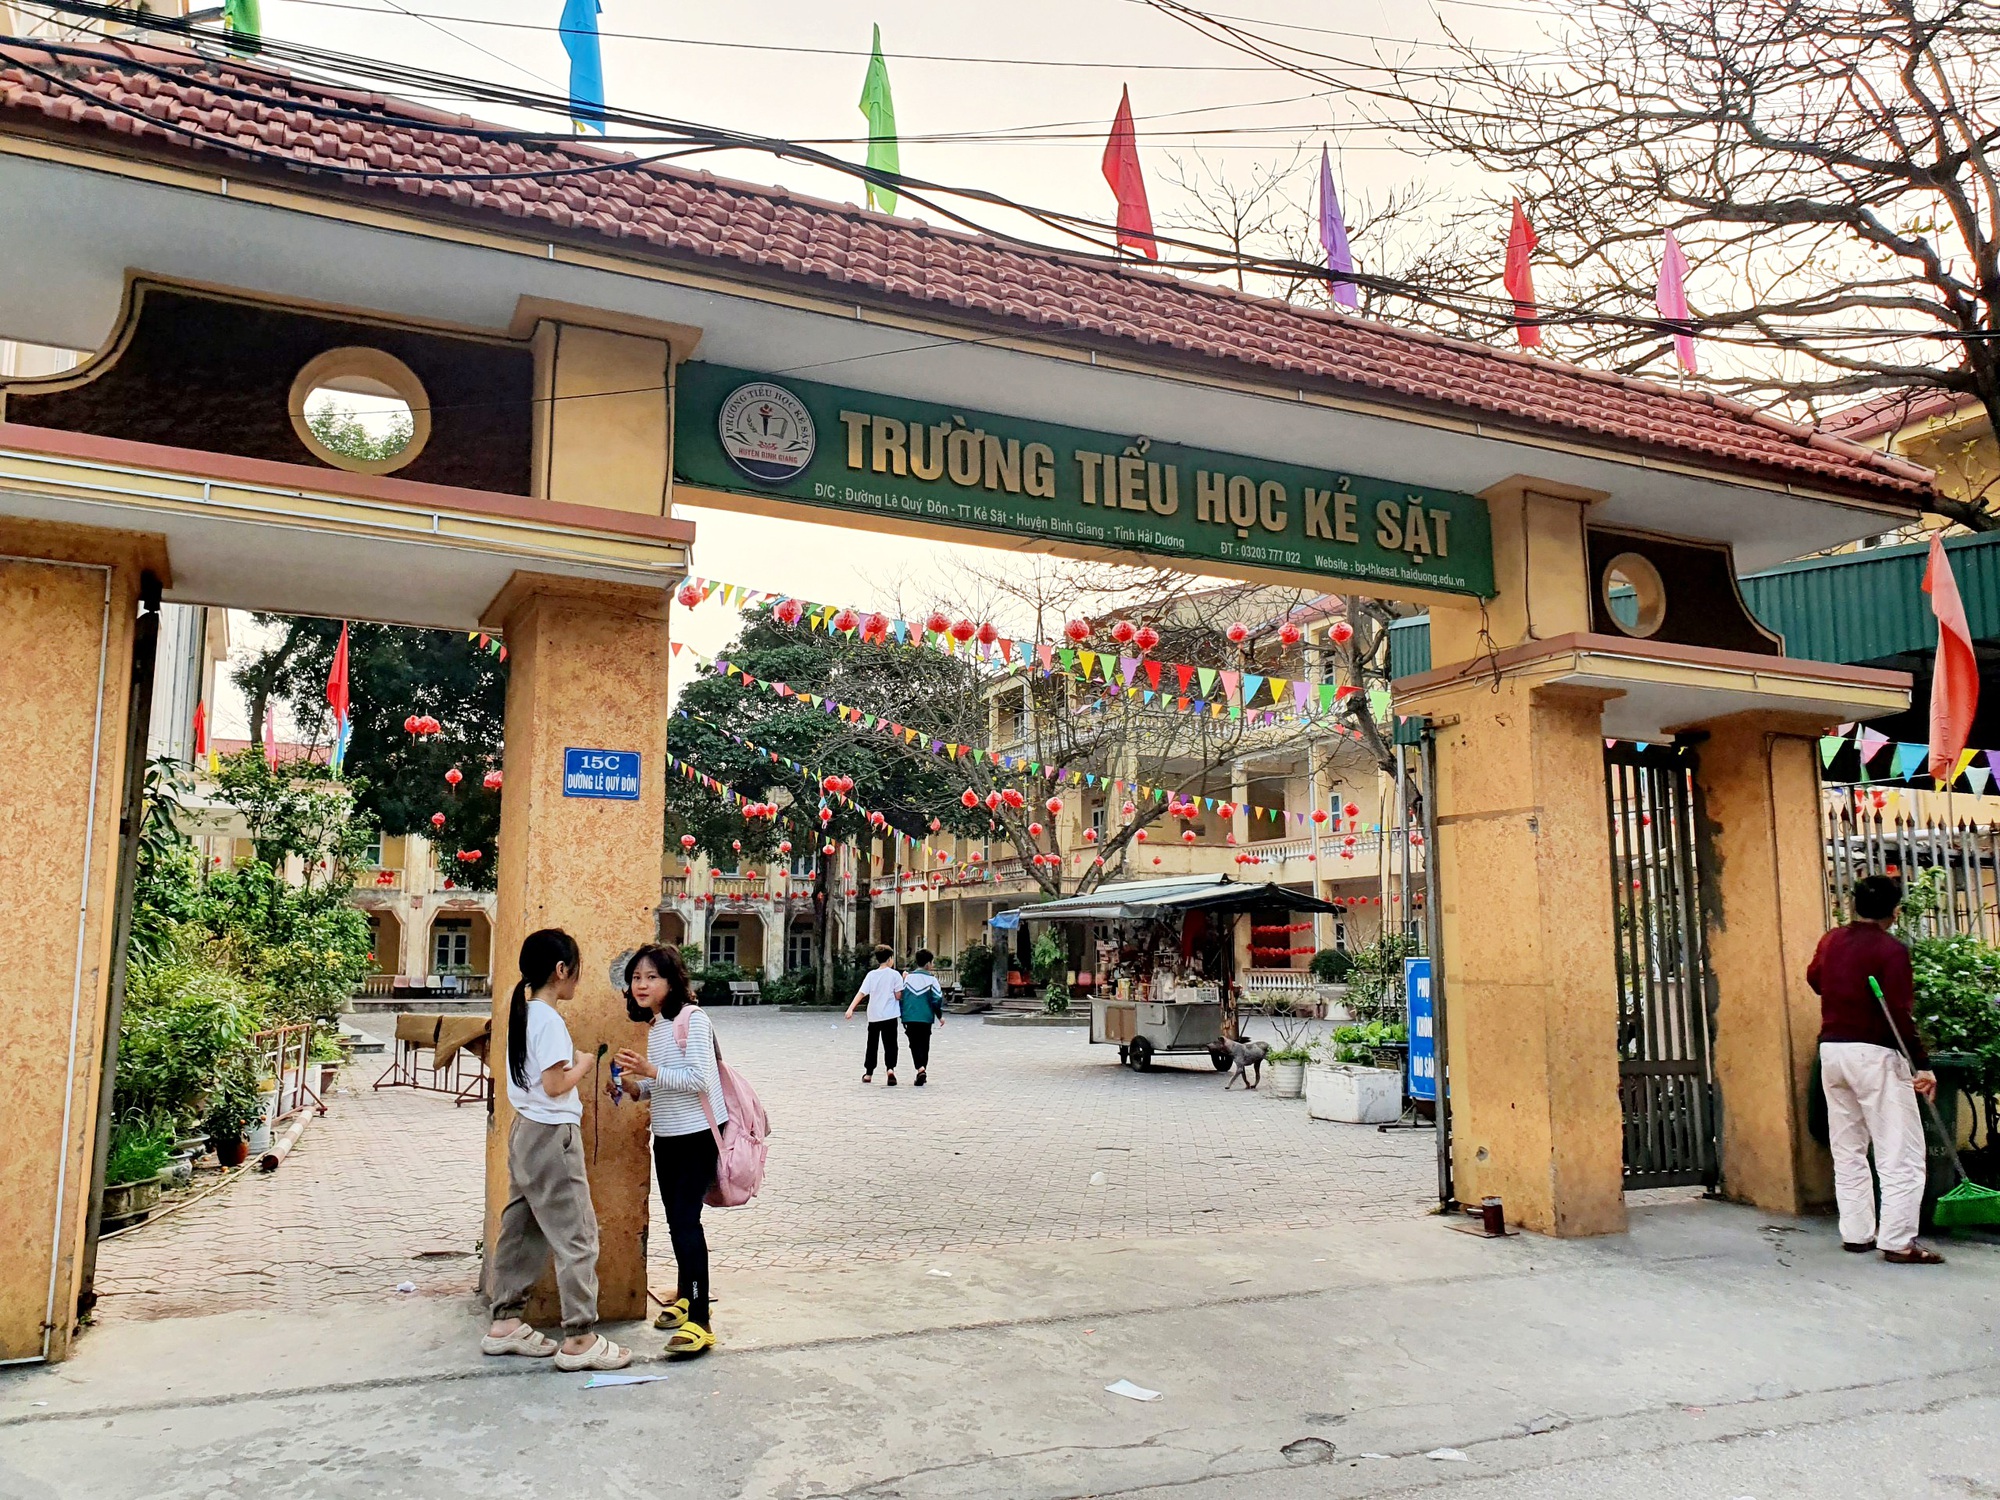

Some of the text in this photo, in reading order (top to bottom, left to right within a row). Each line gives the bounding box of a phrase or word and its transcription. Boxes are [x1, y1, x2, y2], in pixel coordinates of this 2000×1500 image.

[778, 454, 798, 465] GIANG
[839, 409, 1451, 564] TRƯỜNG TIỂU HỌC KẺ SẶT
[815, 483, 836, 498] Đ/C
[845, 488, 882, 508] Đường
[885, 493, 898, 507] Lê
[901, 496, 922, 514] Quý
[927, 499, 949, 515] Đôn
[958, 504, 971, 517] TT
[974, 506, 988, 521] Kẻ
[990, 509, 1007, 526] Sặt
[1017, 513, 1048, 531] Huyện
[1051, 517, 1073, 533] Bình
[1076, 522, 1104, 540] Giang
[1114, 526, 1135, 541] Tỉnh
[1138, 528, 1153, 544] Hải
[1155, 532, 1185, 549] Dương
[1220, 542, 1233, 554] ĐT
[1241, 545, 1266, 559] 03203
[1268, 549, 1283, 562] 777
[1285, 551, 1300, 564] 022
[1315, 555, 1348, 571] Website
[581, 755, 620, 770] 15C
[595, 772, 604, 790] LÊ
[605, 773, 620, 792] QUÝ
[1417, 977, 1430, 1003] PHỤ
[1416, 1012, 1433, 1038] KHÔN
